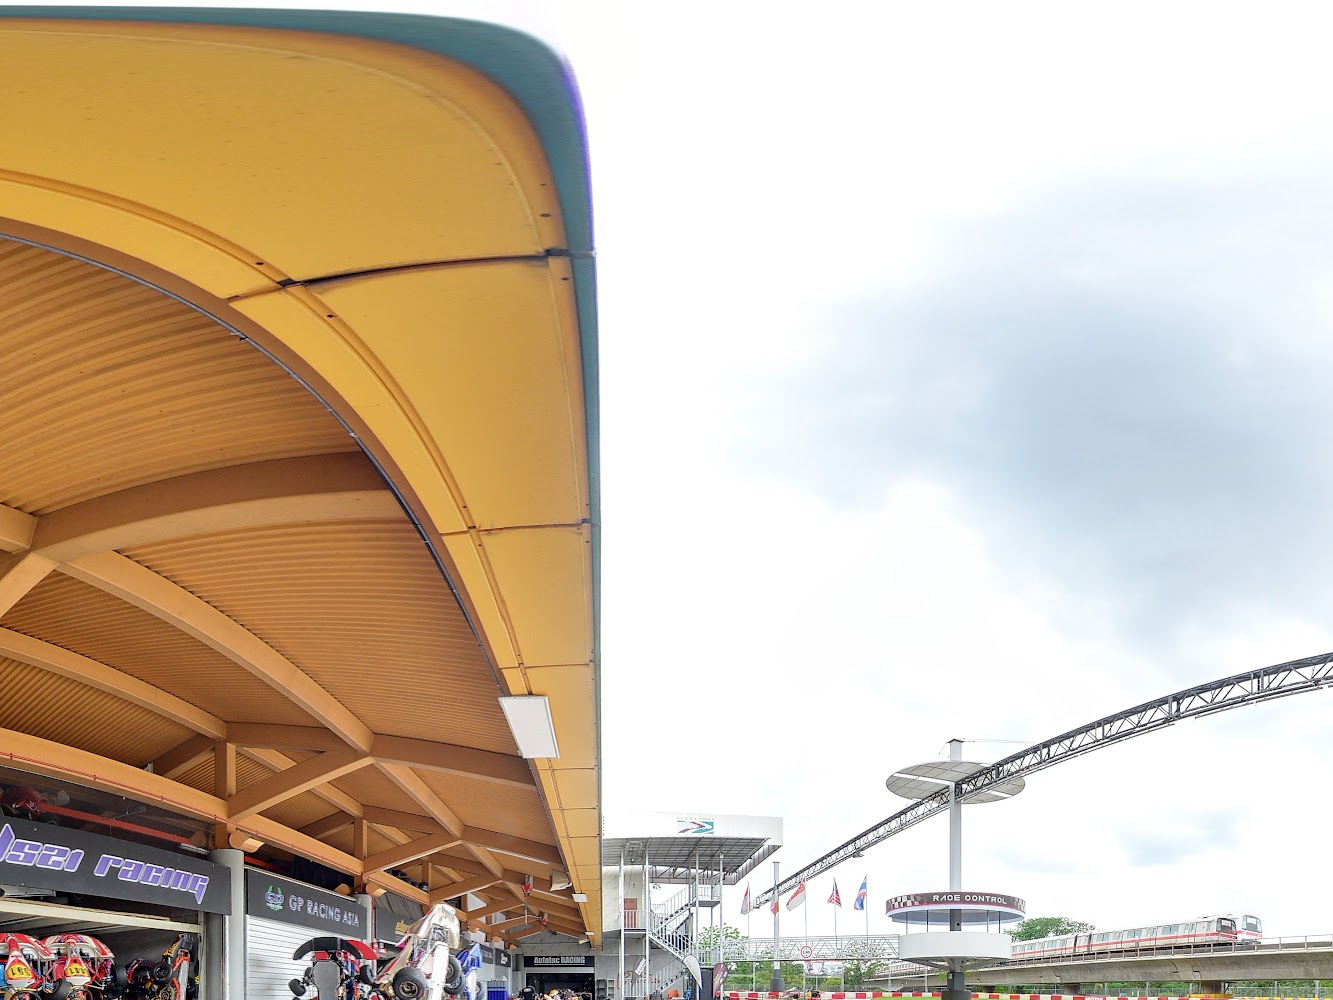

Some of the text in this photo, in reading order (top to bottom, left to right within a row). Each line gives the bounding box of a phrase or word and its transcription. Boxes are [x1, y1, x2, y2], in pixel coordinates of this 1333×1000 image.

[93, 854, 210, 905] racing
[288, 895, 303, 912] GP
[306, 900, 341, 922] RACING
[342, 911, 360, 928] ASIA
[561, 956, 586, 964] RACING
